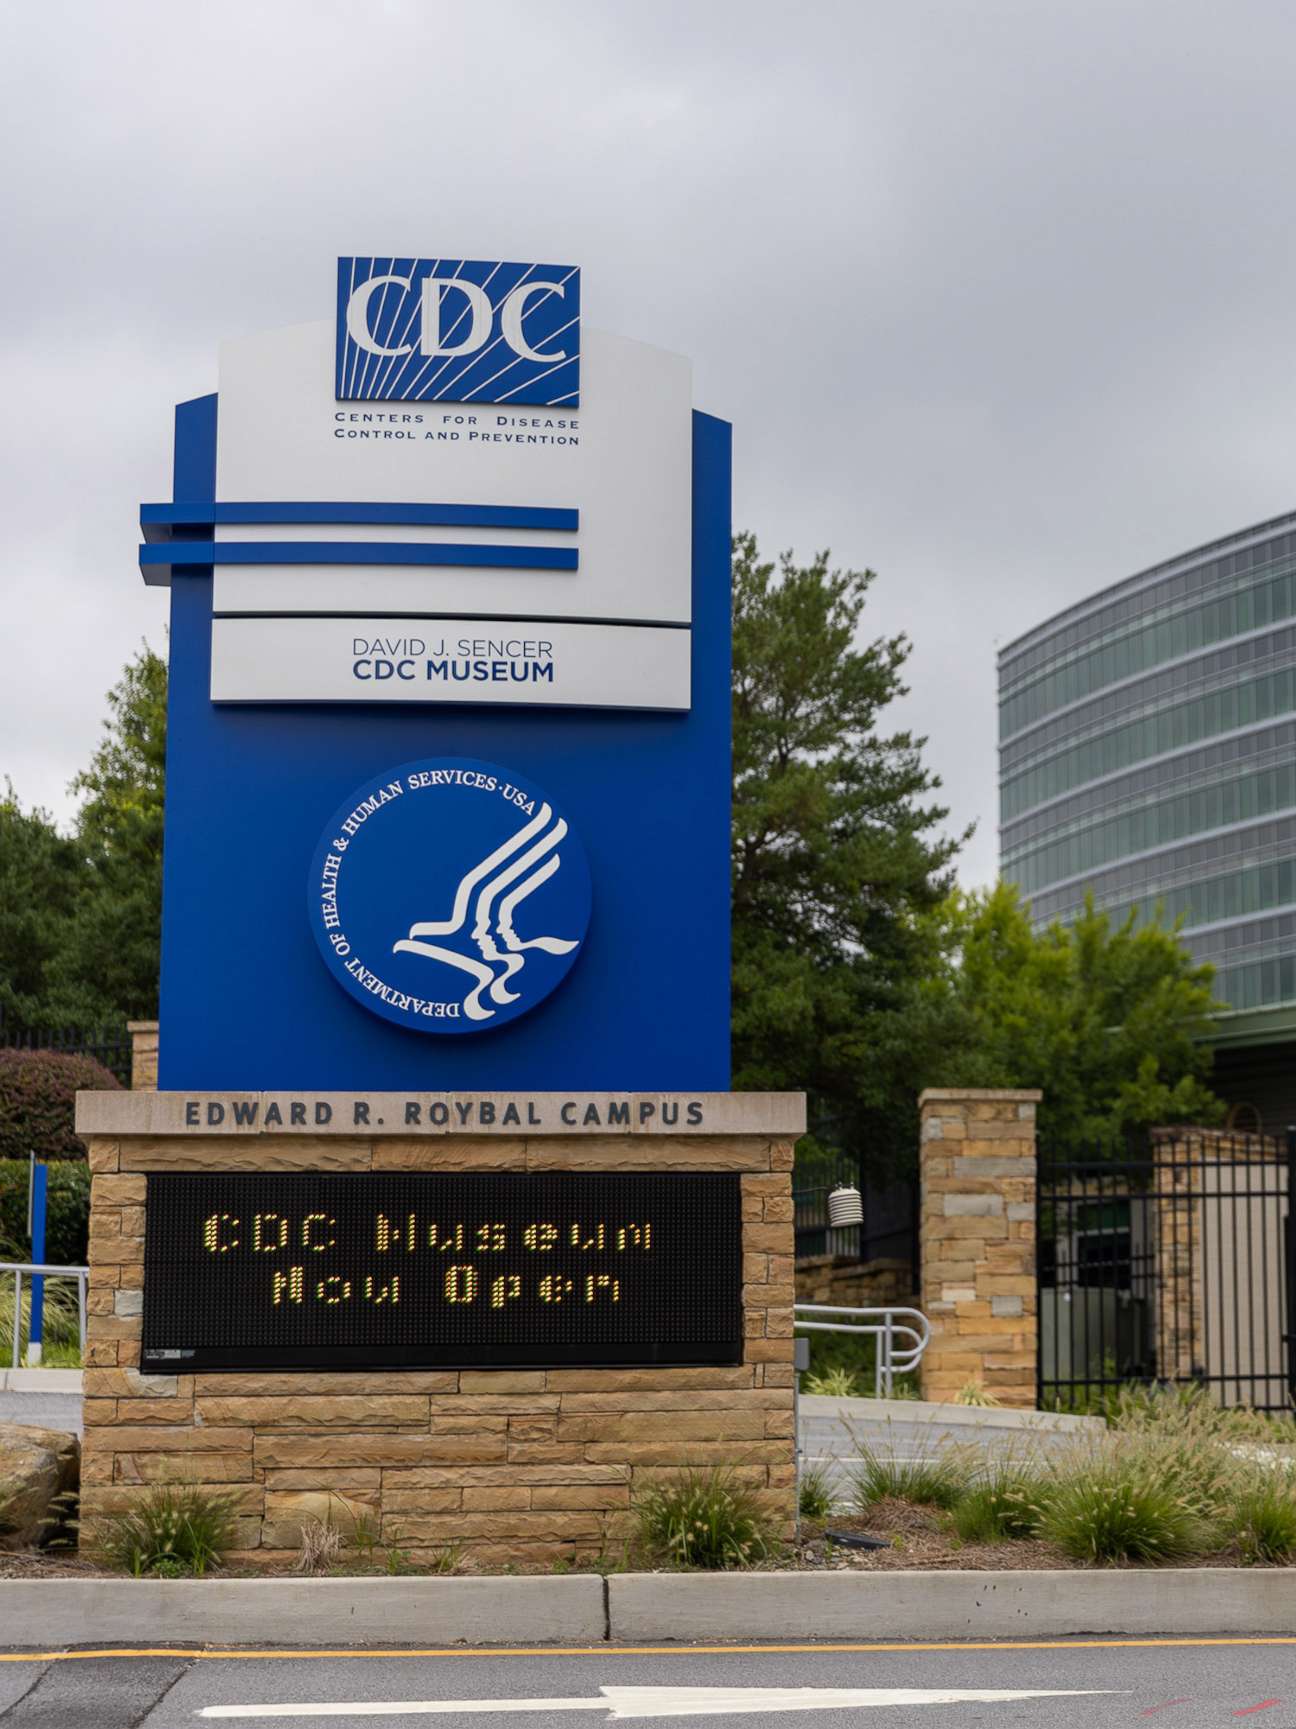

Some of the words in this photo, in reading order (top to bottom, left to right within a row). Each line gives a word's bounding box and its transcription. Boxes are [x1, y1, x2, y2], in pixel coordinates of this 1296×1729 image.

[346, 275, 567, 363] CDC
[443, 415, 478, 426] FOR
[424, 431, 460, 441] AND
[353, 638, 426, 656] DAVID
[433, 639, 449, 657] J.
[457, 640, 553, 658] SENCER
[353, 659, 416, 680] CDC
[427, 660, 553, 682] MUSEUM
[341, 780, 405, 836] HUMAN
[332, 837, 350, 852] &
[321, 854, 342, 930] HEALTH
[329, 933, 351, 956] OF
[345, 958, 461, 1018] DEPARTMENT
[186, 1101, 333, 1126] EDWARD
[353, 1101, 385, 1126] R.
[405, 1101, 542, 1126] ROYBAL
[560, 1101, 705, 1126] CAMPUS
[204, 1213, 340, 1252] CDC
[374, 1212, 652, 1252] Museum
[273, 1266, 401, 1304] Now
[444, 1264, 620, 1308] Open
